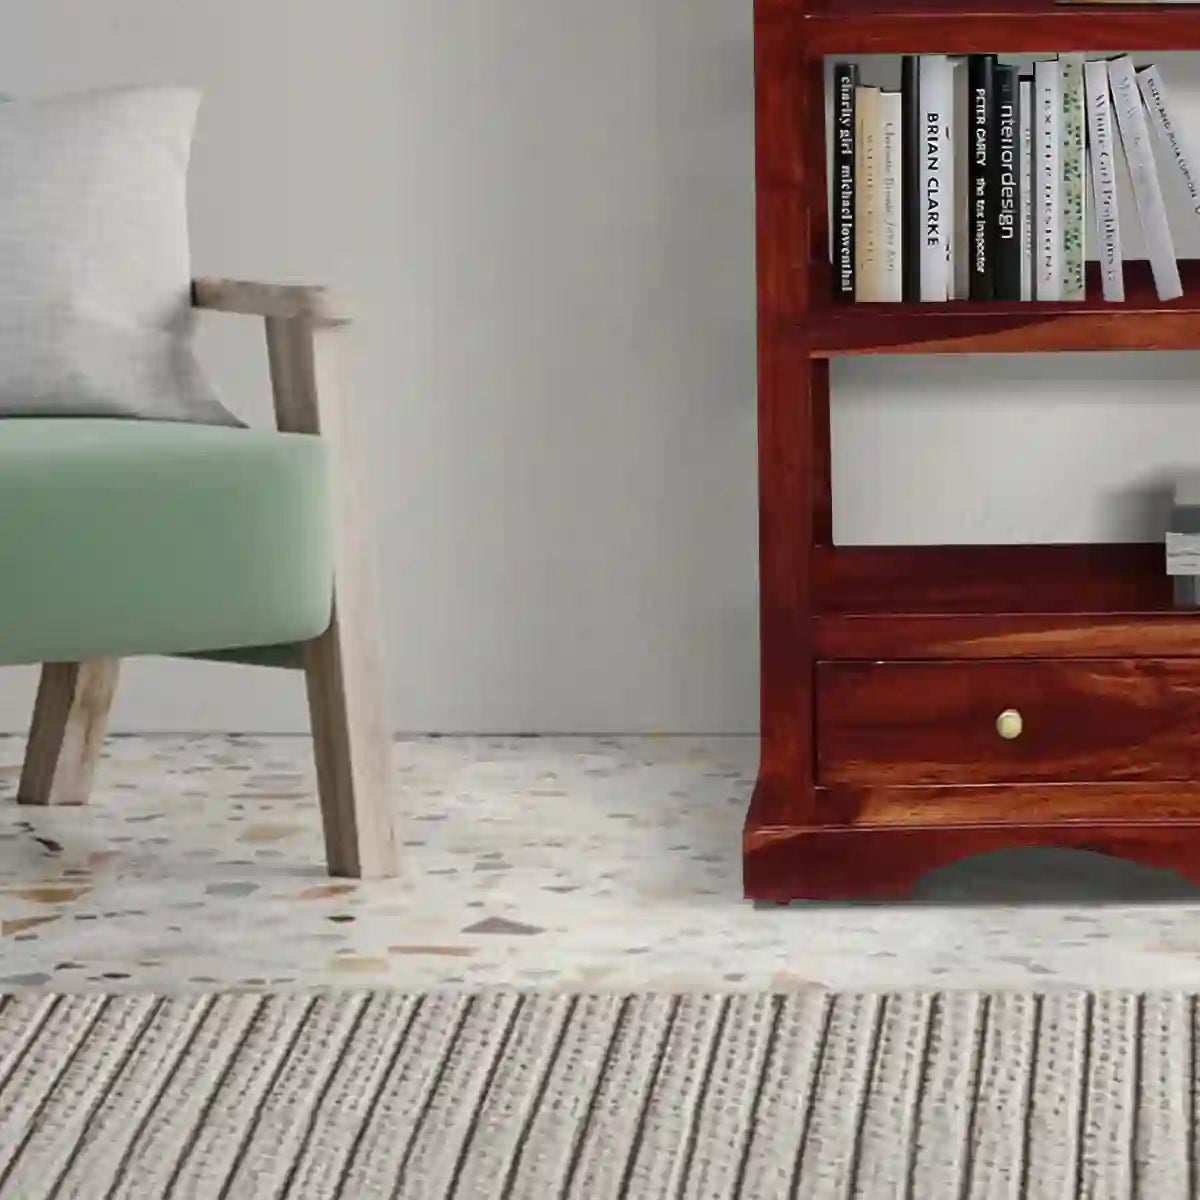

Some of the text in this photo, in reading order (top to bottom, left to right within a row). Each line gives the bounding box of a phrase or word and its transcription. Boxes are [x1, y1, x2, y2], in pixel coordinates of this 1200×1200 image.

[839, 76, 853, 127] charity
[839, 128, 853, 155] girl
[927, 113, 940, 247] BRIAN CLARKE
[840, 223, 853, 292] lowenthal
